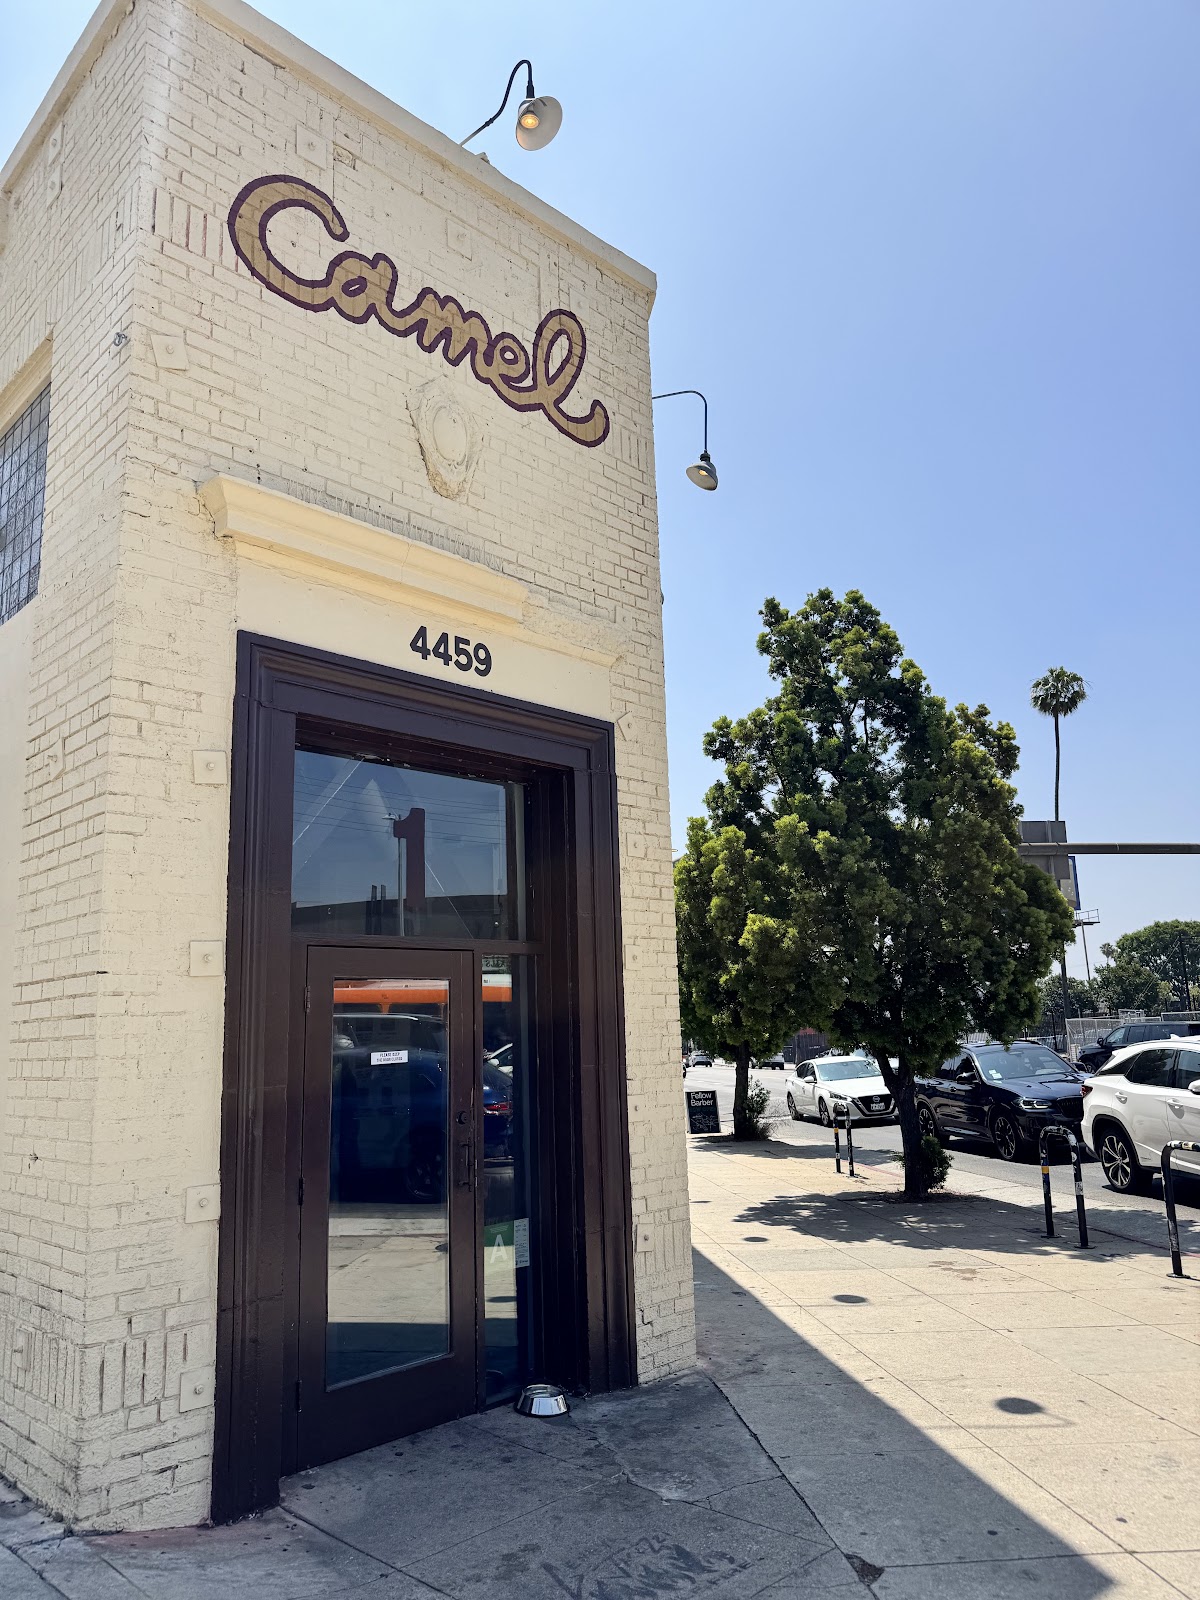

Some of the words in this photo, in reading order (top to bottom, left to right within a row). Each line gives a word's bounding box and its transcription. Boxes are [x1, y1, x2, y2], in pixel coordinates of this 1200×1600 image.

[228, 174, 610, 447] Camel
[409, 625, 492, 677] 4459
[690, 1099, 713, 1107] Barber
[490, 1234, 508, 1264] A
